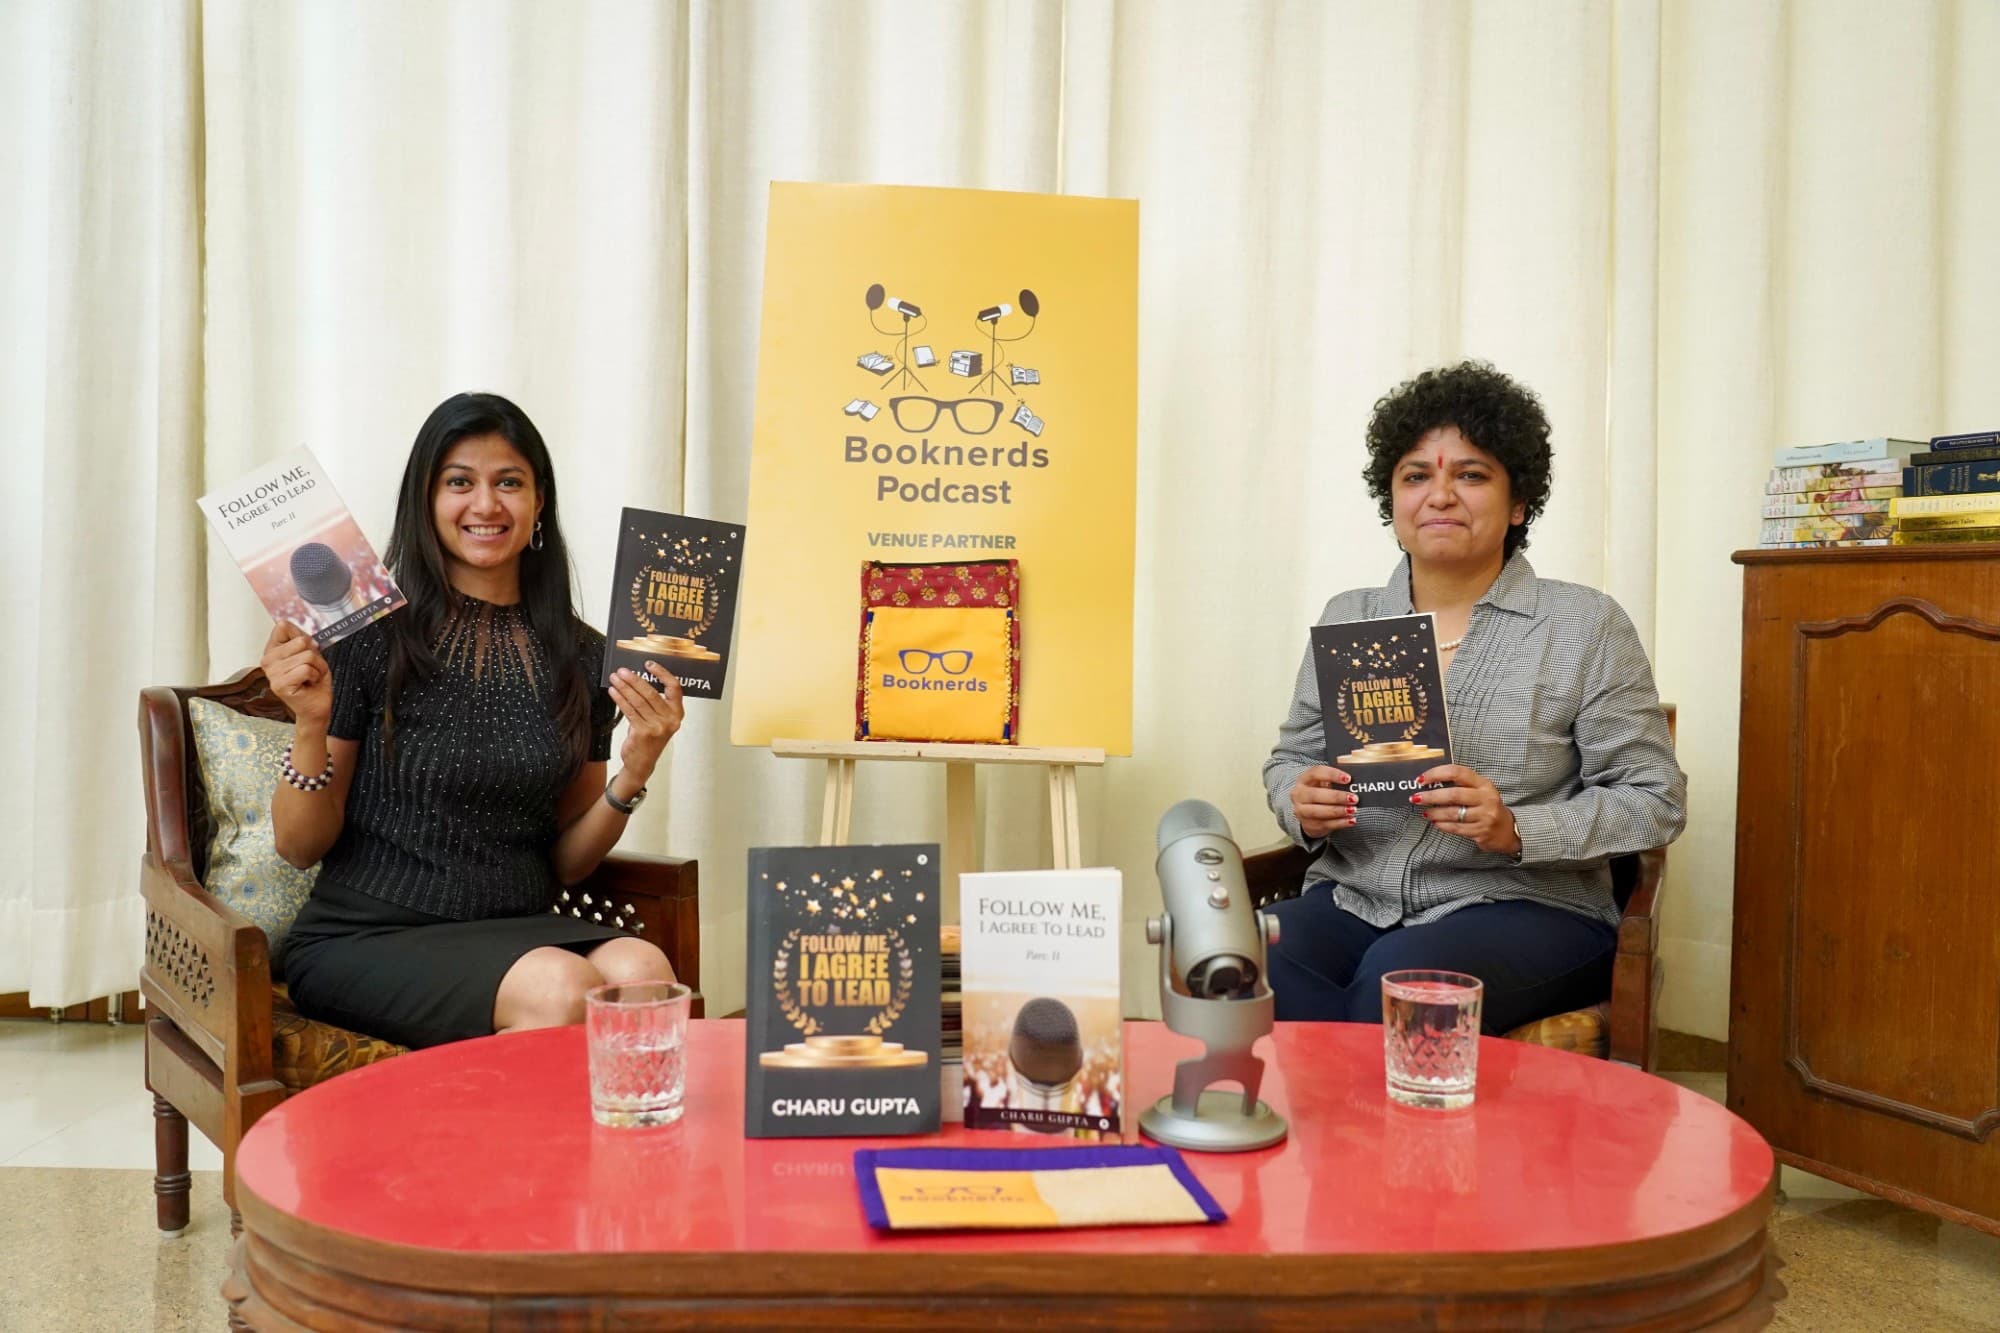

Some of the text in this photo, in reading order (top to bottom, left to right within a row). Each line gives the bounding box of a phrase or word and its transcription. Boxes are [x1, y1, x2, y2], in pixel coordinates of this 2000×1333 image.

[844, 435, 1050, 468] Booknerds
[218, 465, 312, 518] FOLLOW ME,
[877, 475, 1012, 504] Podcast
[228, 478, 317, 531] I AGREE TO LEAD
[867, 532, 1017, 550] VENUE PARTNER
[650, 570, 690, 586] FOLLOW
[648, 582, 705, 605] I AGREE
[646, 598, 704, 622] TO LEAD
[318, 604, 379, 641] CHARU GUPTA
[676, 676, 712, 690] UPTA
[882, 674, 988, 692] Booknerds
[1351, 678, 1391, 692] FOLLOW
[1353, 689, 1412, 709] I AGREE
[1353, 705, 1415, 726] TO LEAD
[1349, 781, 1396, 793] CHARU
[978, 897, 1107, 921] FOLLOW ME,
[979, 920, 1105, 938] I AGREE TO LEAD
[800, 934, 891, 955] FOLLOW ME,
[801, 953, 889, 980] I AGREE
[797, 980, 891, 1007] TO LEAD
[772, 1097, 921, 1117] CHARU GUPTA
[1000, 1110, 1089, 1126] CHARU GUPTA
